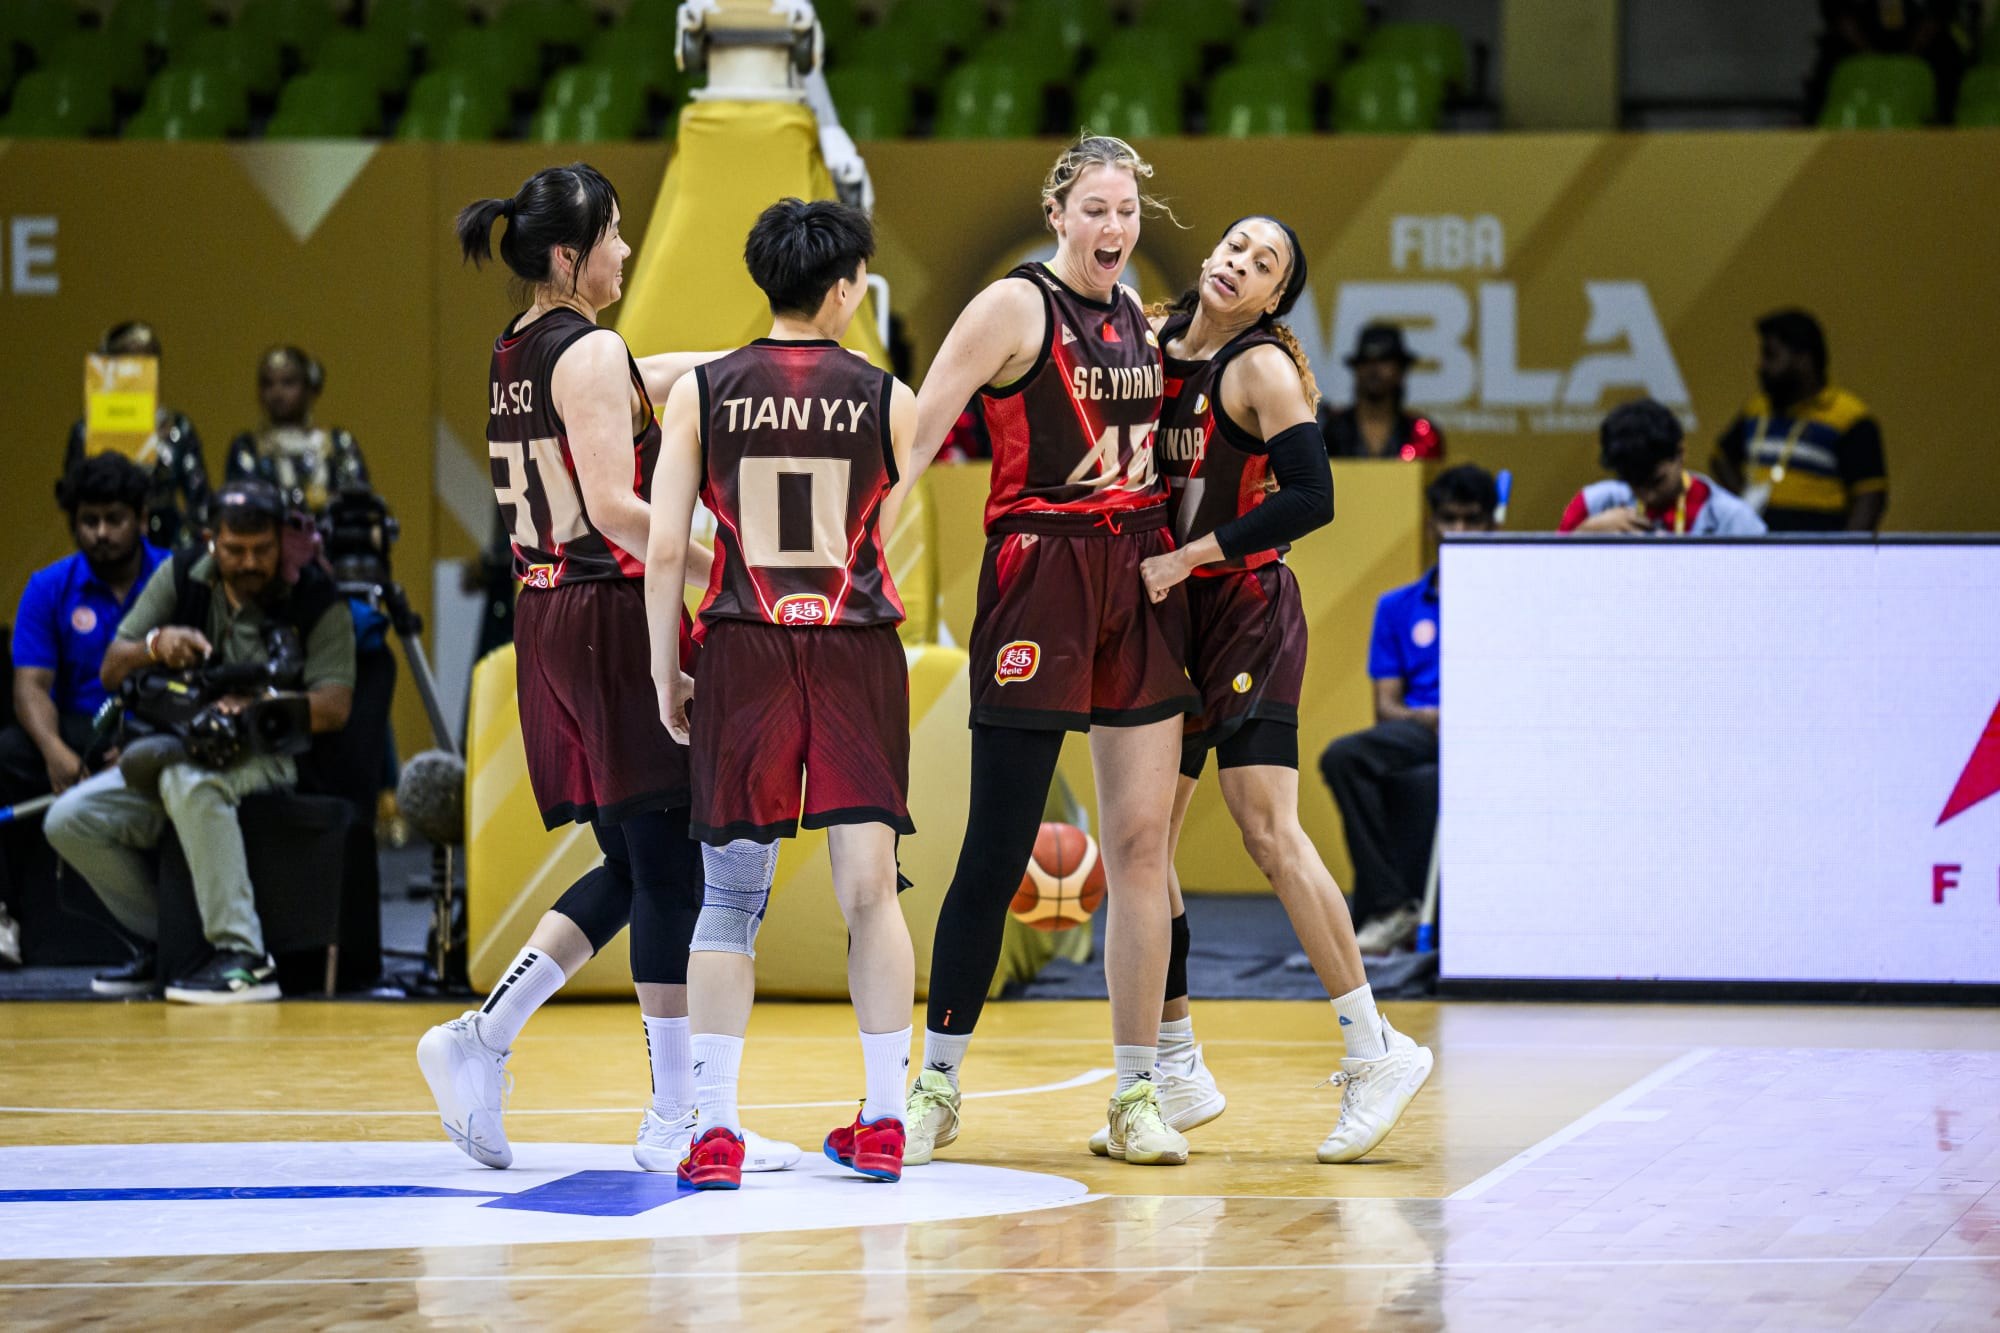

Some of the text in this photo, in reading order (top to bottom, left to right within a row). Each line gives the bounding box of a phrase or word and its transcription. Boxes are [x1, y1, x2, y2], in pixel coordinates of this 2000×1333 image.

[0, 215, 60, 295] E
[1391, 214, 1504, 271] FIBA
[1072, 363, 1163, 400] SC.YUAND
[722, 396, 869, 433] TIAN Y.Y
[738, 456, 852, 569] 0
[1000, 667, 1023, 676] Meile
